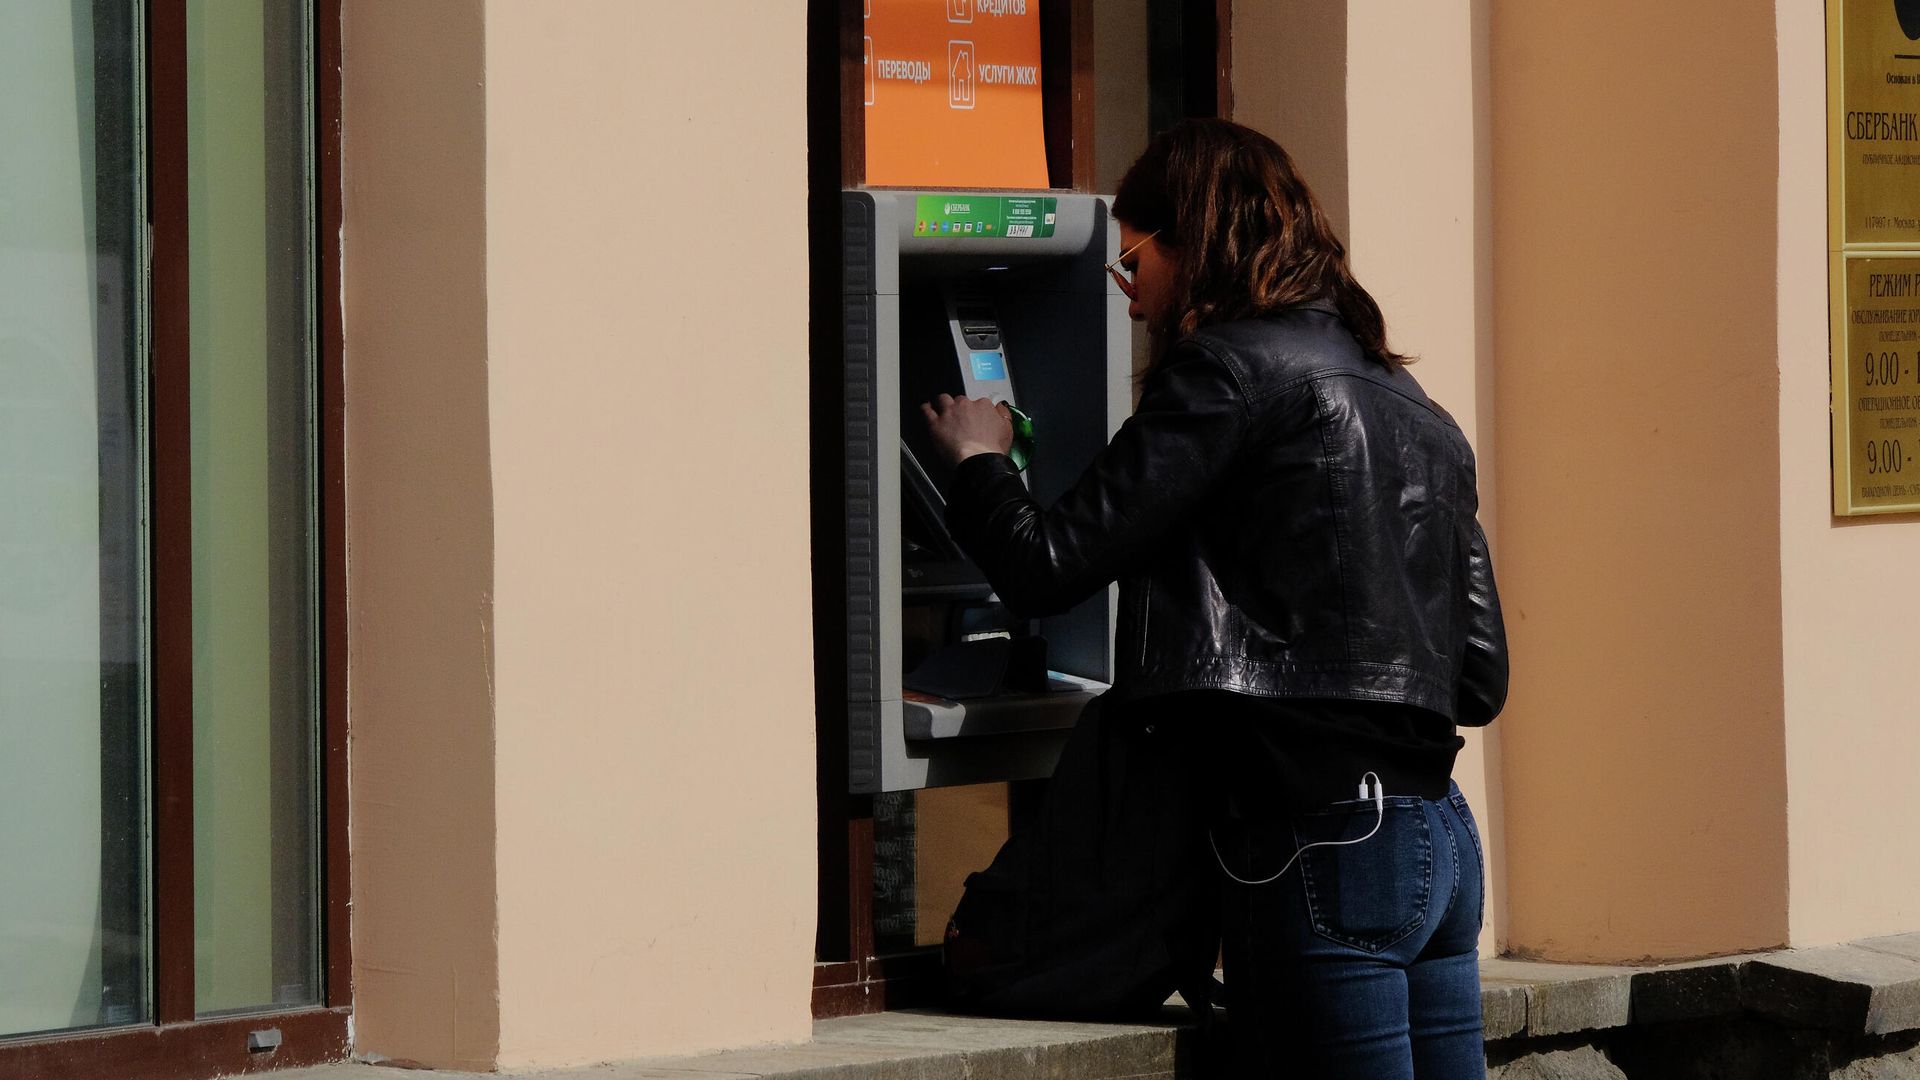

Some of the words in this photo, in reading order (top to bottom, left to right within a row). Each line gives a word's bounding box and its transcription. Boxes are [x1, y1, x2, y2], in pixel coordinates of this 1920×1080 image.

[977, 0, 1026, 17] КРЕДИТОВ
[878, 60, 931, 84] ПЕРЕВОДЫ
[979, 64, 1015, 84] УСЛУГИ
[1016, 66, 1037, 85] ЖКХ
[1847, 111, 1918, 141] СБЕРБАНК
[1870, 274, 1911, 297] РЕЖИМ
[1866, 352, 1899, 386] 9.00
[1868, 440, 1902, 474] 9.00
